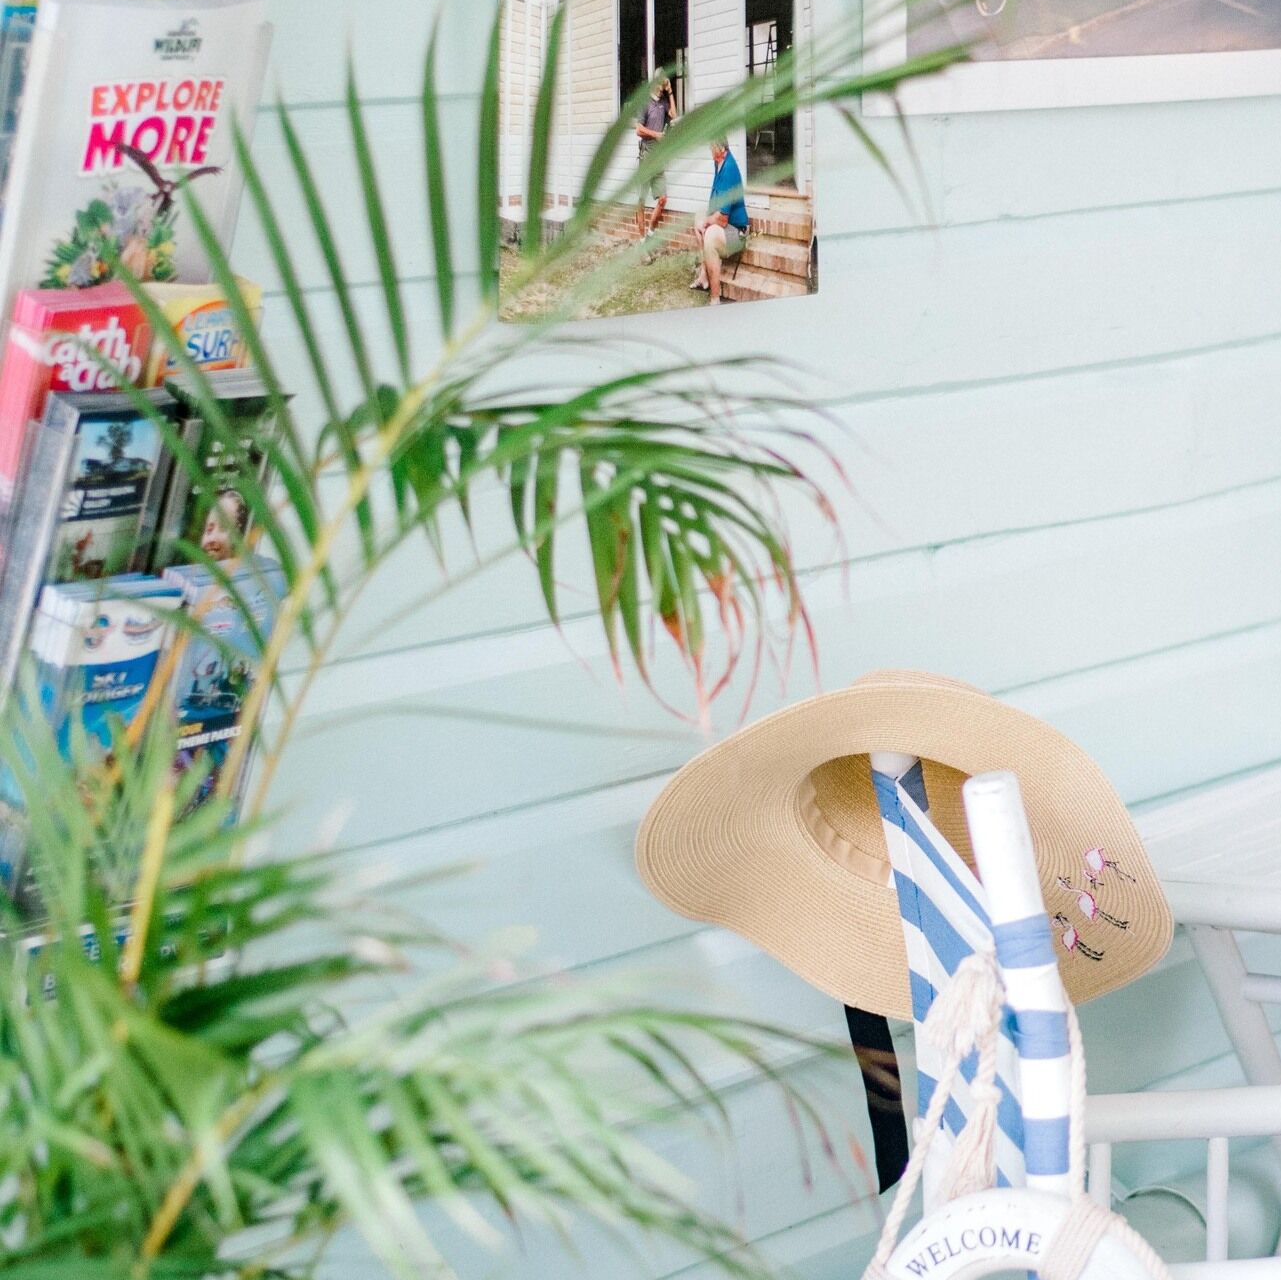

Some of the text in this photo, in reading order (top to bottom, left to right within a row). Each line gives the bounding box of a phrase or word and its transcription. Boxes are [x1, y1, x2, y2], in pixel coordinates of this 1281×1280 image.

[92, 79, 223, 116] EXPLORE
[83, 117, 215, 171] MORE
[905, 1227, 1042, 1280] WELCOME
